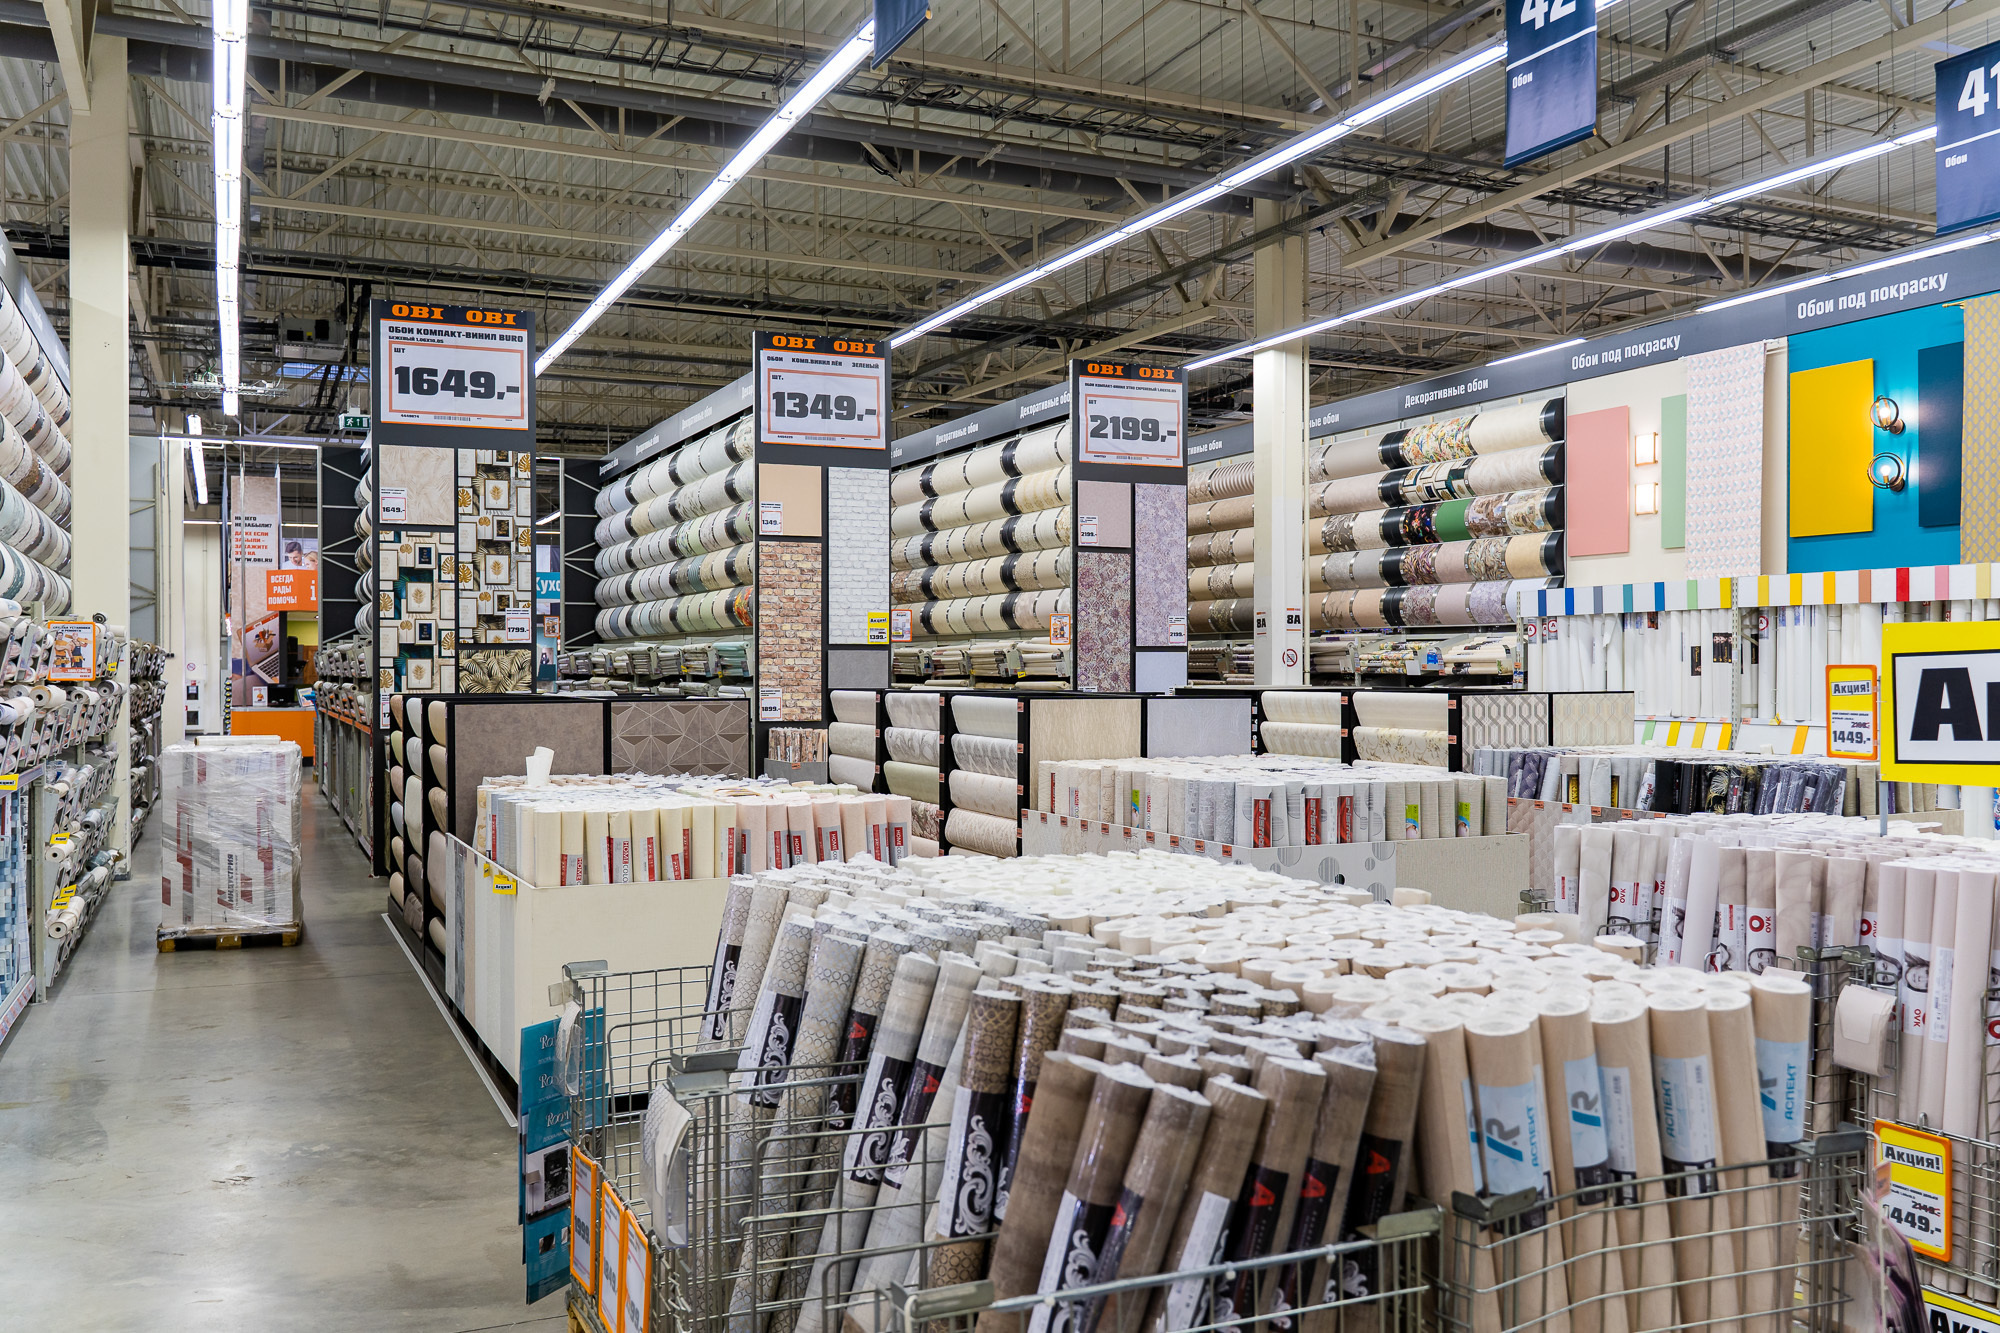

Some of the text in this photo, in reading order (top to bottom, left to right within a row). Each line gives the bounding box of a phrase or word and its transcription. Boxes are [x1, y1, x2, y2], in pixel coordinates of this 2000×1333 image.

[1512, 72, 1533, 89] Обои
[1945, 154, 1967, 168] Обои
[1798, 272, 1948, 320] Обои под покраску
[392, 304, 517, 325] OBI OBI
[388, 326, 524, 342] ОБОИ КОМПАКТ-ВИНИЛ BURO
[772, 336, 875, 354] OBI OBI
[1571, 334, 1681, 370] Обои под покраску
[1088, 363, 1175, 379] OBI OBI
[395, 366, 519, 400] 1649,-
[1404, 378, 1489, 409] Декоративные обои
[772, 392, 876, 421] 1349,-
[1020, 396, 1060, 419] Декоративные
[1322, 412, 1340, 425] обои
[935, 422, 978, 446] Декоративные обои
[1090, 415, 1176, 442] 2199,-
[1208, 439, 1222, 452] обои
[270, 574, 293, 583] ВСЕГДА
[273, 586, 291, 594] РАДЫ
[268, 596, 297, 604] ПОМОЧЬ!
[1287, 615, 1301, 624] 8A
[1833, 682, 1870, 695] Акция!
[1833, 730, 1870, 744] 1449,-
[1913, 1008, 1922, 1027] OVK
[1784, 1063, 1796, 1120] АСПЕКТ
[1661, 1077, 1676, 1138] АСПЕКТ
[1526, 1105, 1539, 1167] АСПЕКТ
[1885, 1146, 1940, 1170] Акция!
